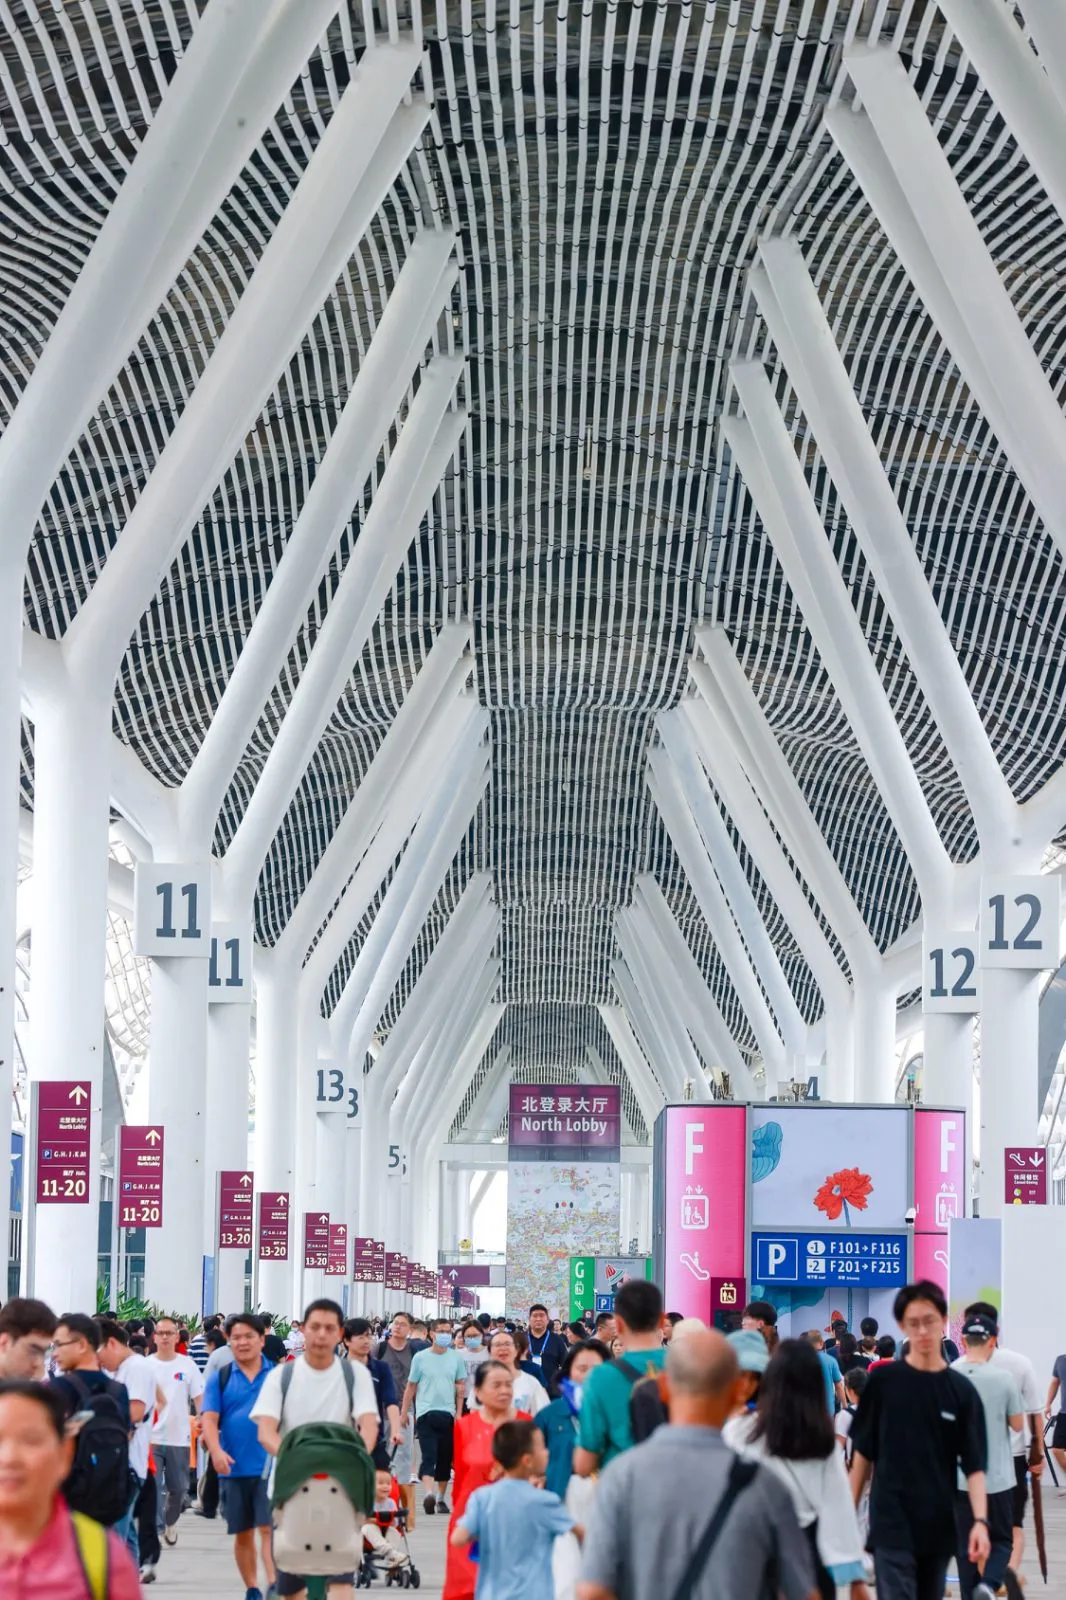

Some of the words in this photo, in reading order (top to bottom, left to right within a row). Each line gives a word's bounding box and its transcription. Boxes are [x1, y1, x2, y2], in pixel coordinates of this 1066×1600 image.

[156, 882, 201, 938] 11
[988, 893, 1043, 950] 12
[929, 947, 977, 997] 12
[316, 1069, 344, 1102] 13
[521, 1096, 609, 1114] 北登录大厅
[521, 1116, 562, 1132] North
[566, 1116, 608, 1136] Lobby
[686, 1123, 705, 1175] F
[940, 1120, 957, 1173] F
[42, 1180, 86, 1197] 11-20
[123, 1207, 160, 1222] 11-20
[221, 1233, 251, 1244] 13-20
[260, 1246, 286, 1257] 13-20
[830, 1241, 860, 1254] F101
[871, 1243, 900, 1255] F116
[305, 1257, 328, 1266] 13-20
[768, 1243, 787, 1275] P
[830, 1260, 860, 1273] F201
[871, 1261, 900, 1274] F215
[575, 1261, 585, 1279] G
[600, 1299, 608, 1309] P
